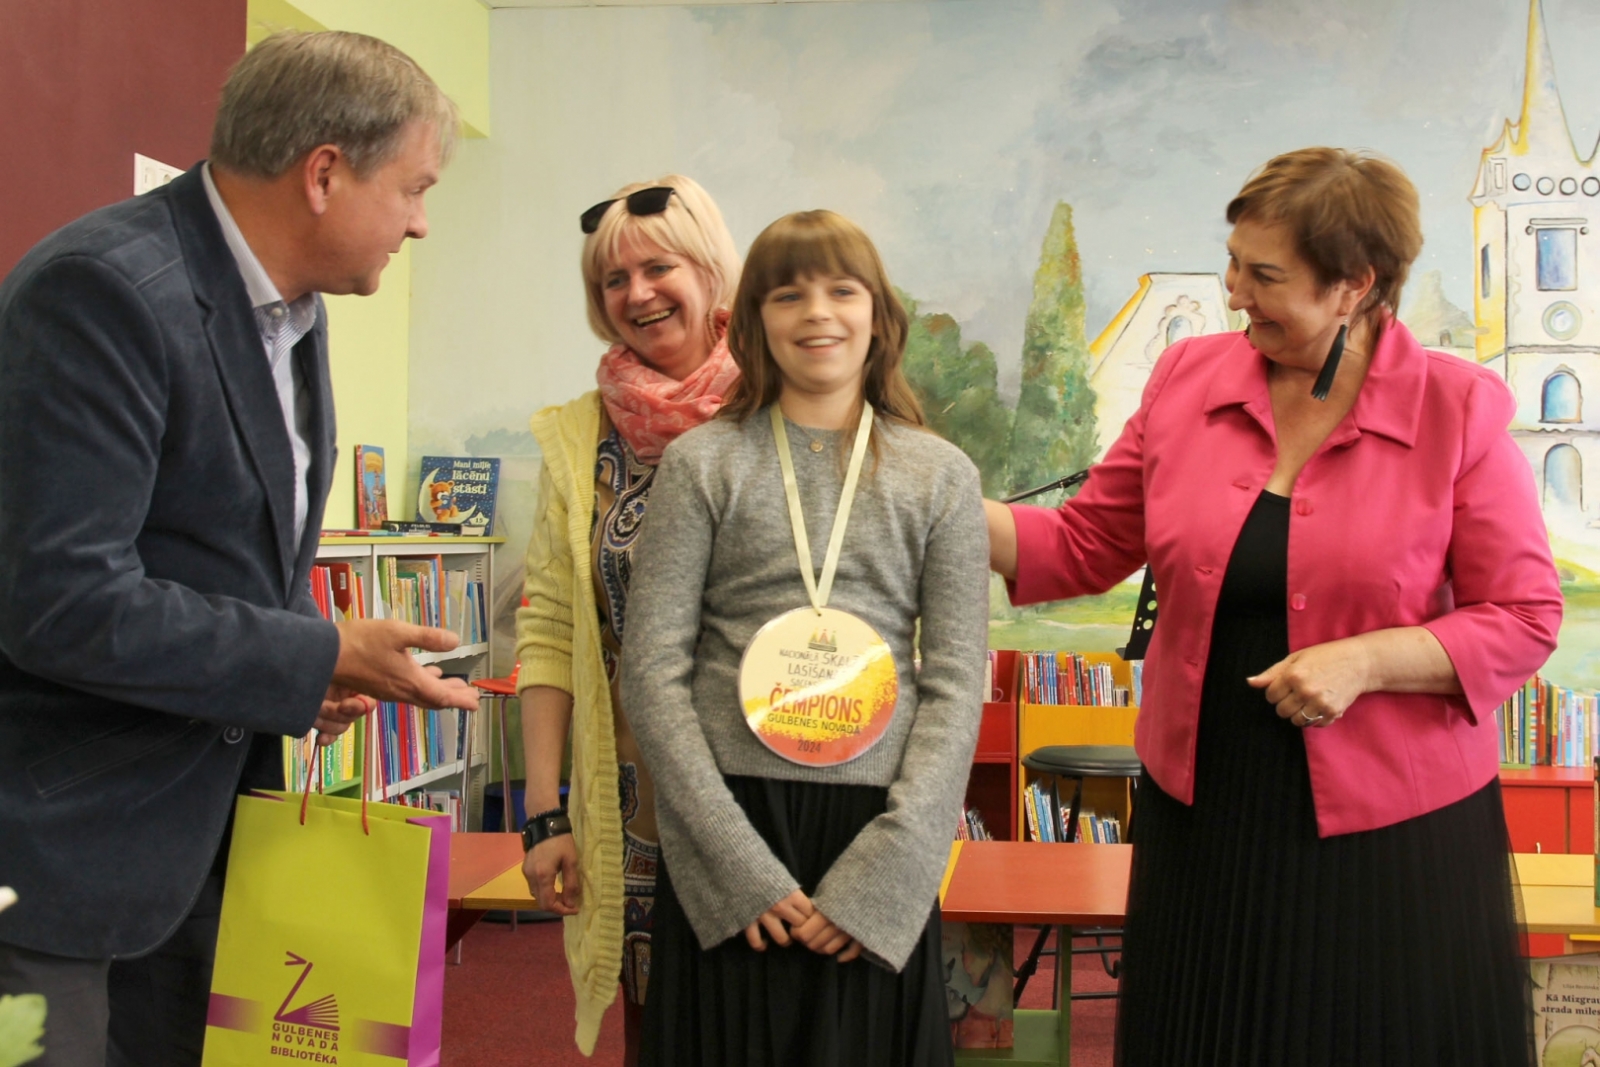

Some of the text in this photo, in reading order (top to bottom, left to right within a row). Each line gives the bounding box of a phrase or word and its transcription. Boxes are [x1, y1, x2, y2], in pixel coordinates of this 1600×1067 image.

[453, 460, 471, 468] Mani
[453, 483, 487, 495] stāsti
[769, 682, 863, 724] ČEMPIONS
[767, 713, 861, 735] GULBENES NOVADA
[797, 740, 822, 753] 2024
[1546, 994, 1558, 1002] Kā
[1540, 1006, 1572, 1014] atrada
[272, 1022, 339, 1041] GULBENES
[271, 1032, 339, 1051] NOVADA
[270, 1045, 338, 1065] BIBLIOTĒKA
